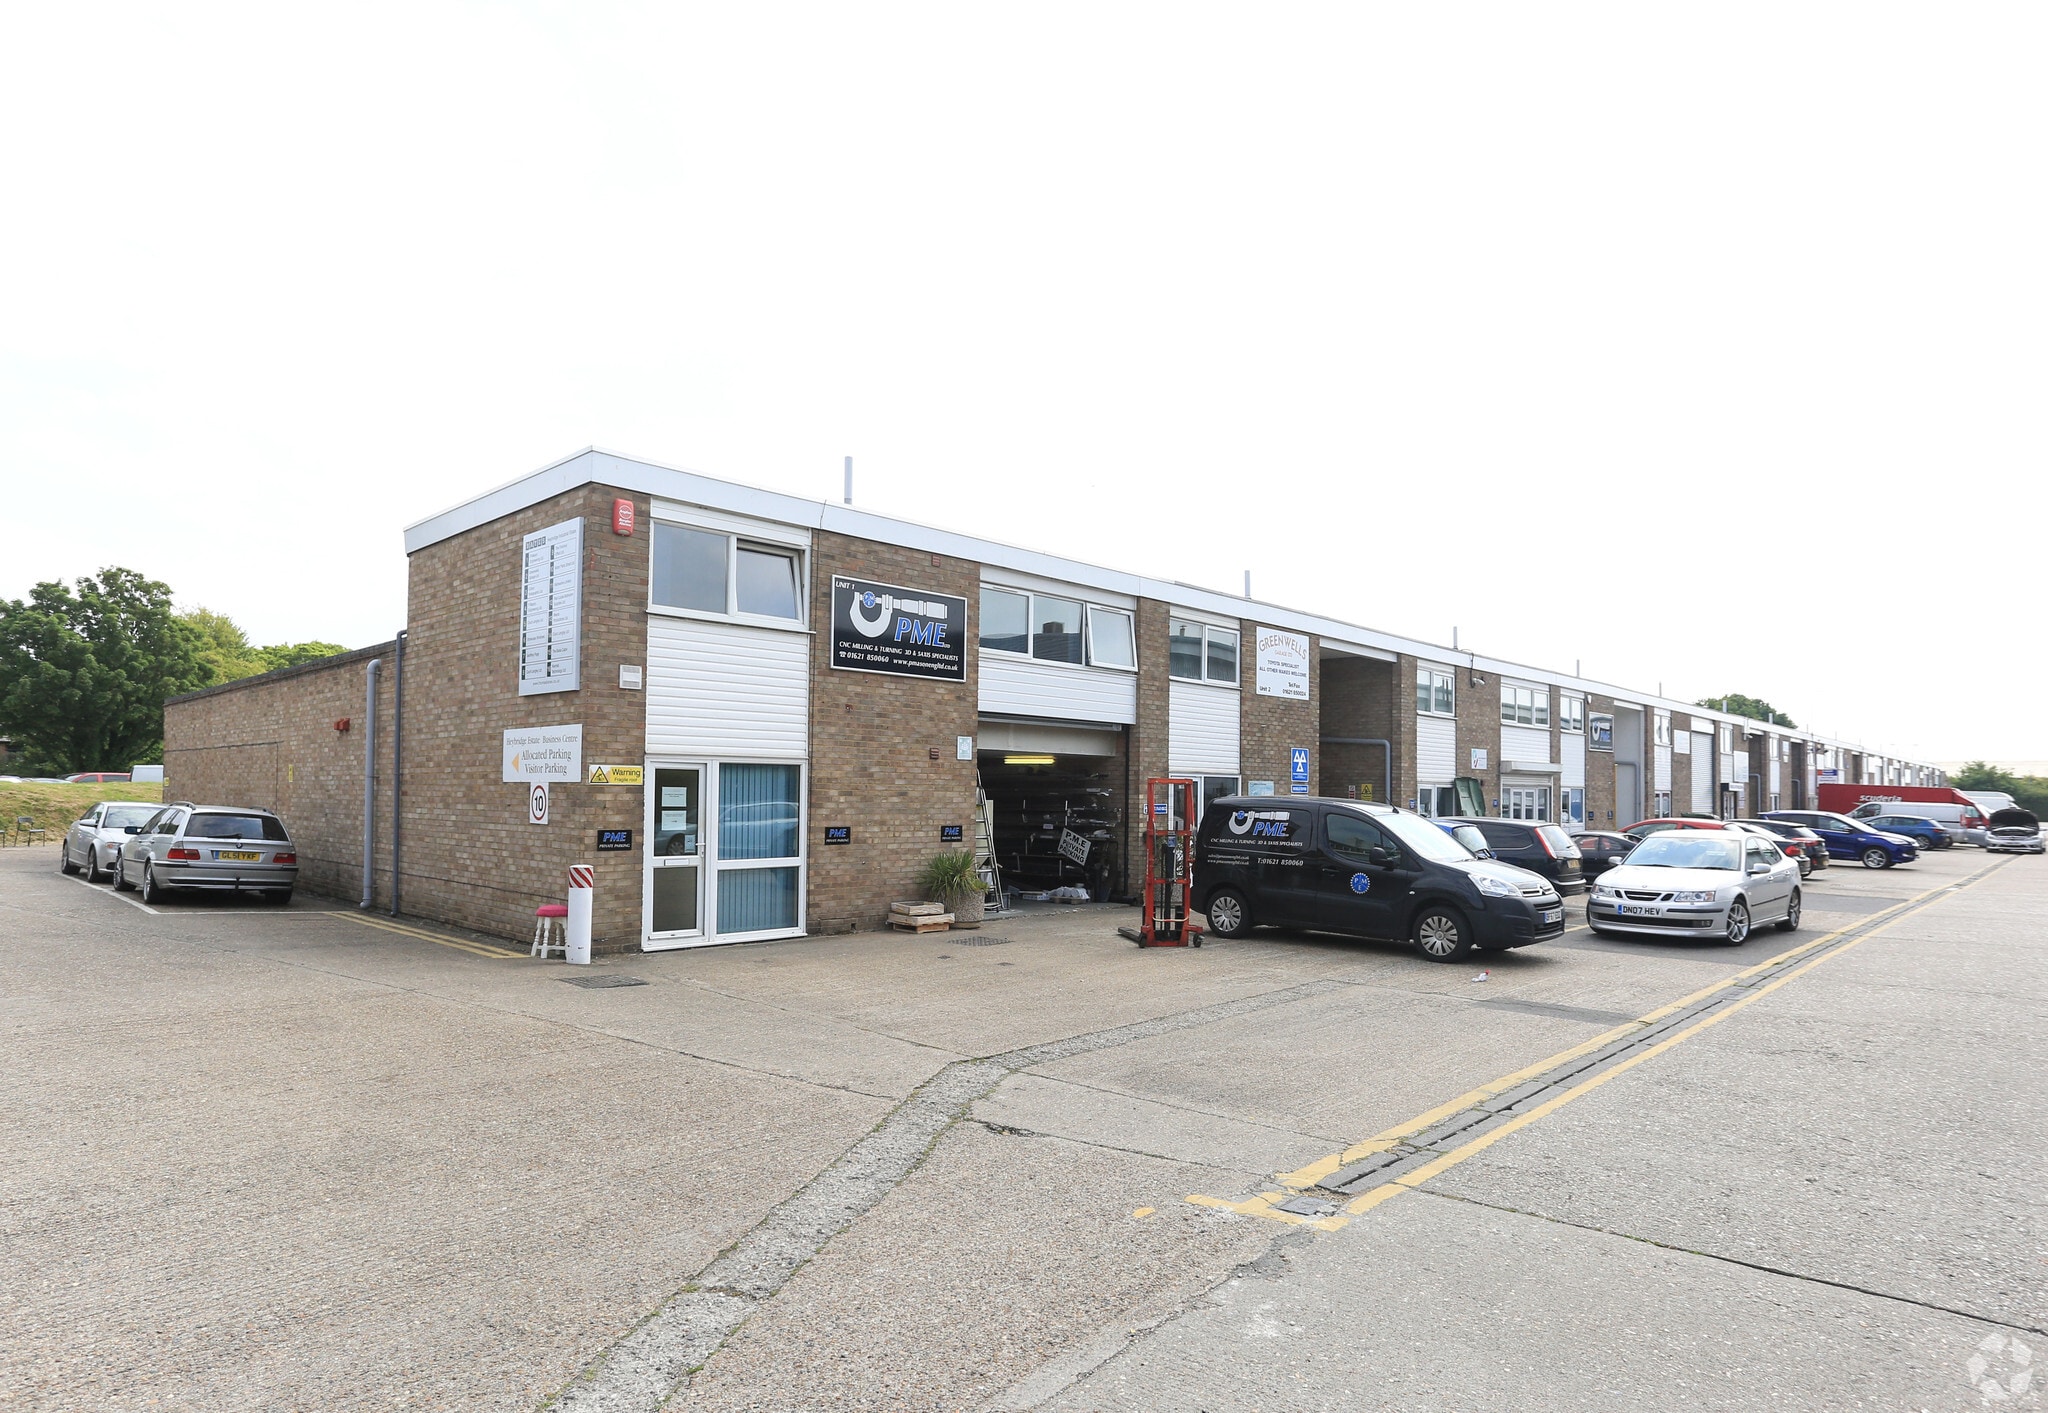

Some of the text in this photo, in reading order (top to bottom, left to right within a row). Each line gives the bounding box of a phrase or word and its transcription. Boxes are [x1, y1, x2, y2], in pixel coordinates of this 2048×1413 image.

[835, 581, 850, 589] UNIT
[894, 616, 948, 648] PME
[839, 641, 851, 649] CNC
[852, 642, 874, 651] MILLING
[880, 646, 903, 655] TURNING
[932, 652, 959, 662] SPECIALISTS
[1258, 635, 1308, 660] GREENWELLS
[846, 651, 959, 671] 01621 850060 www.pmasonengltd.co.uk
[506, 734, 578, 748] Heybridge Estate Business Centre
[521, 748, 572, 762] Allocated Parking
[525, 762, 568, 776] Visitor Parking
[612, 768, 641, 778] Warning
[534, 795, 544, 812] 10
[1859, 794, 1903, 802] scuderia
[829, 828, 847, 838] PME
[944, 827, 960, 836] PME
[1252, 821, 1289, 837] PME
[602, 831, 627, 842] PME
[1059, 843, 1085, 863] PAKING
[1062, 839, 1085, 856] PIVATE
[1257, 857, 1304, 867] T:01621 850060
[1622, 906, 1661, 916] DN07 HEV
